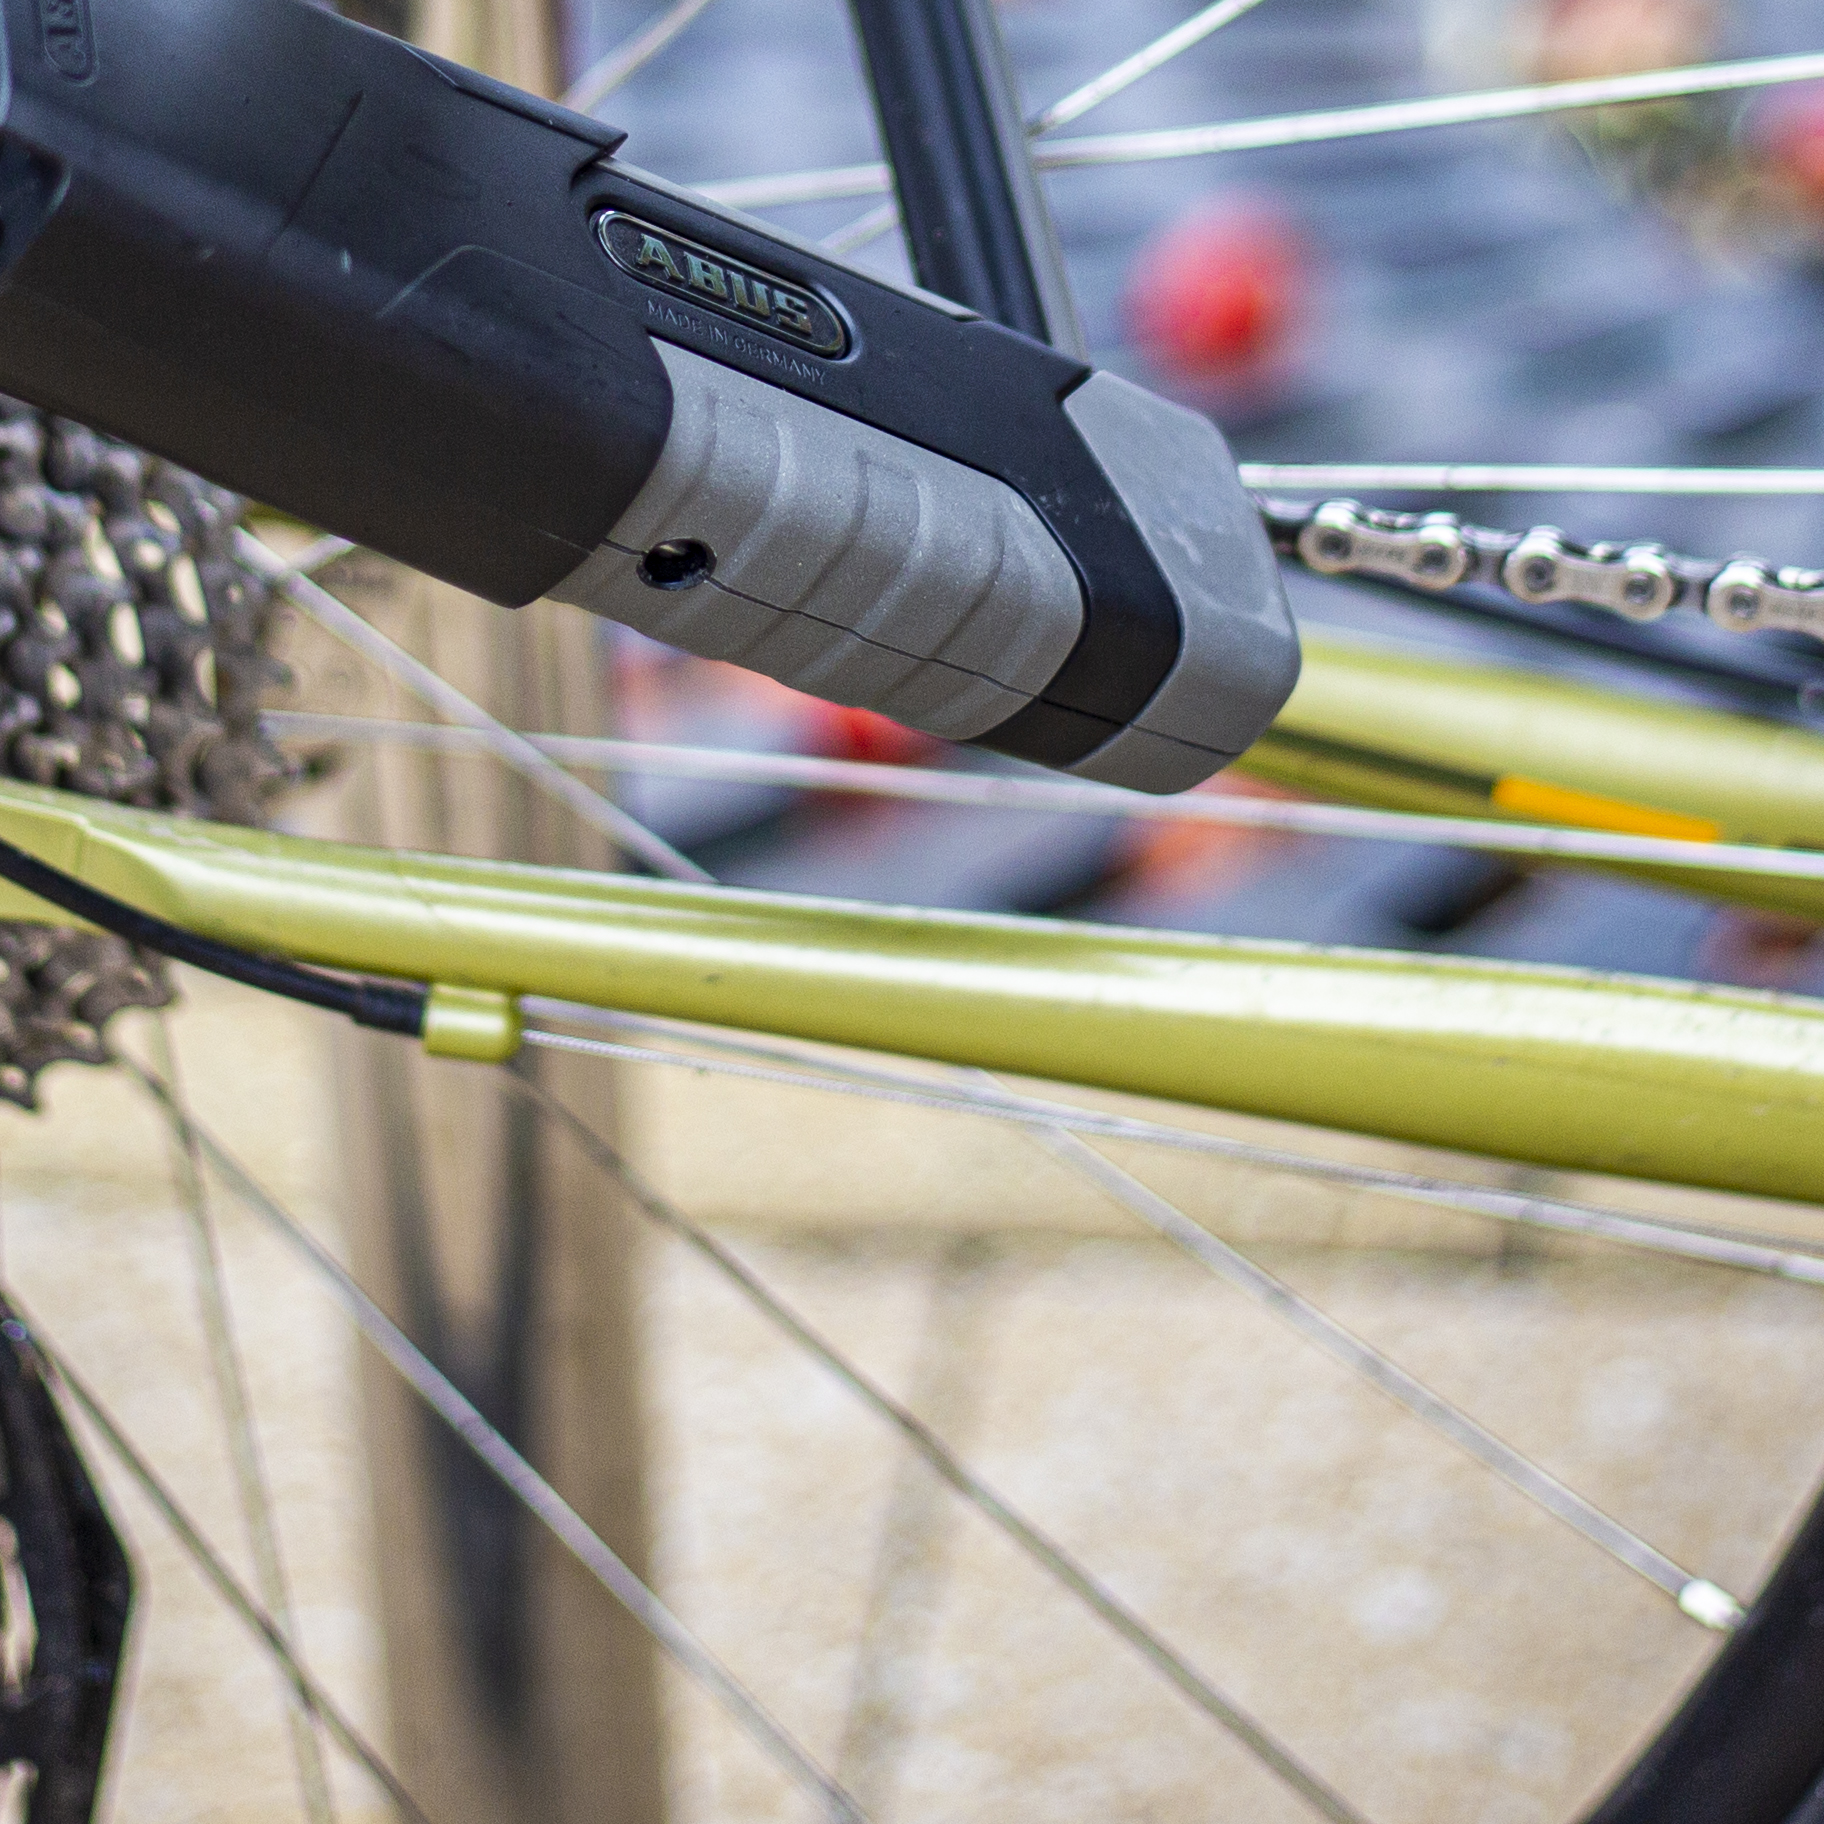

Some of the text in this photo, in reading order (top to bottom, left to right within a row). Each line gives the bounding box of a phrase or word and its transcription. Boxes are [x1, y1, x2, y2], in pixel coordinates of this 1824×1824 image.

[636, 233, 812, 335] ABUS
[646, 299, 827, 386] MADE IN GERMANY
